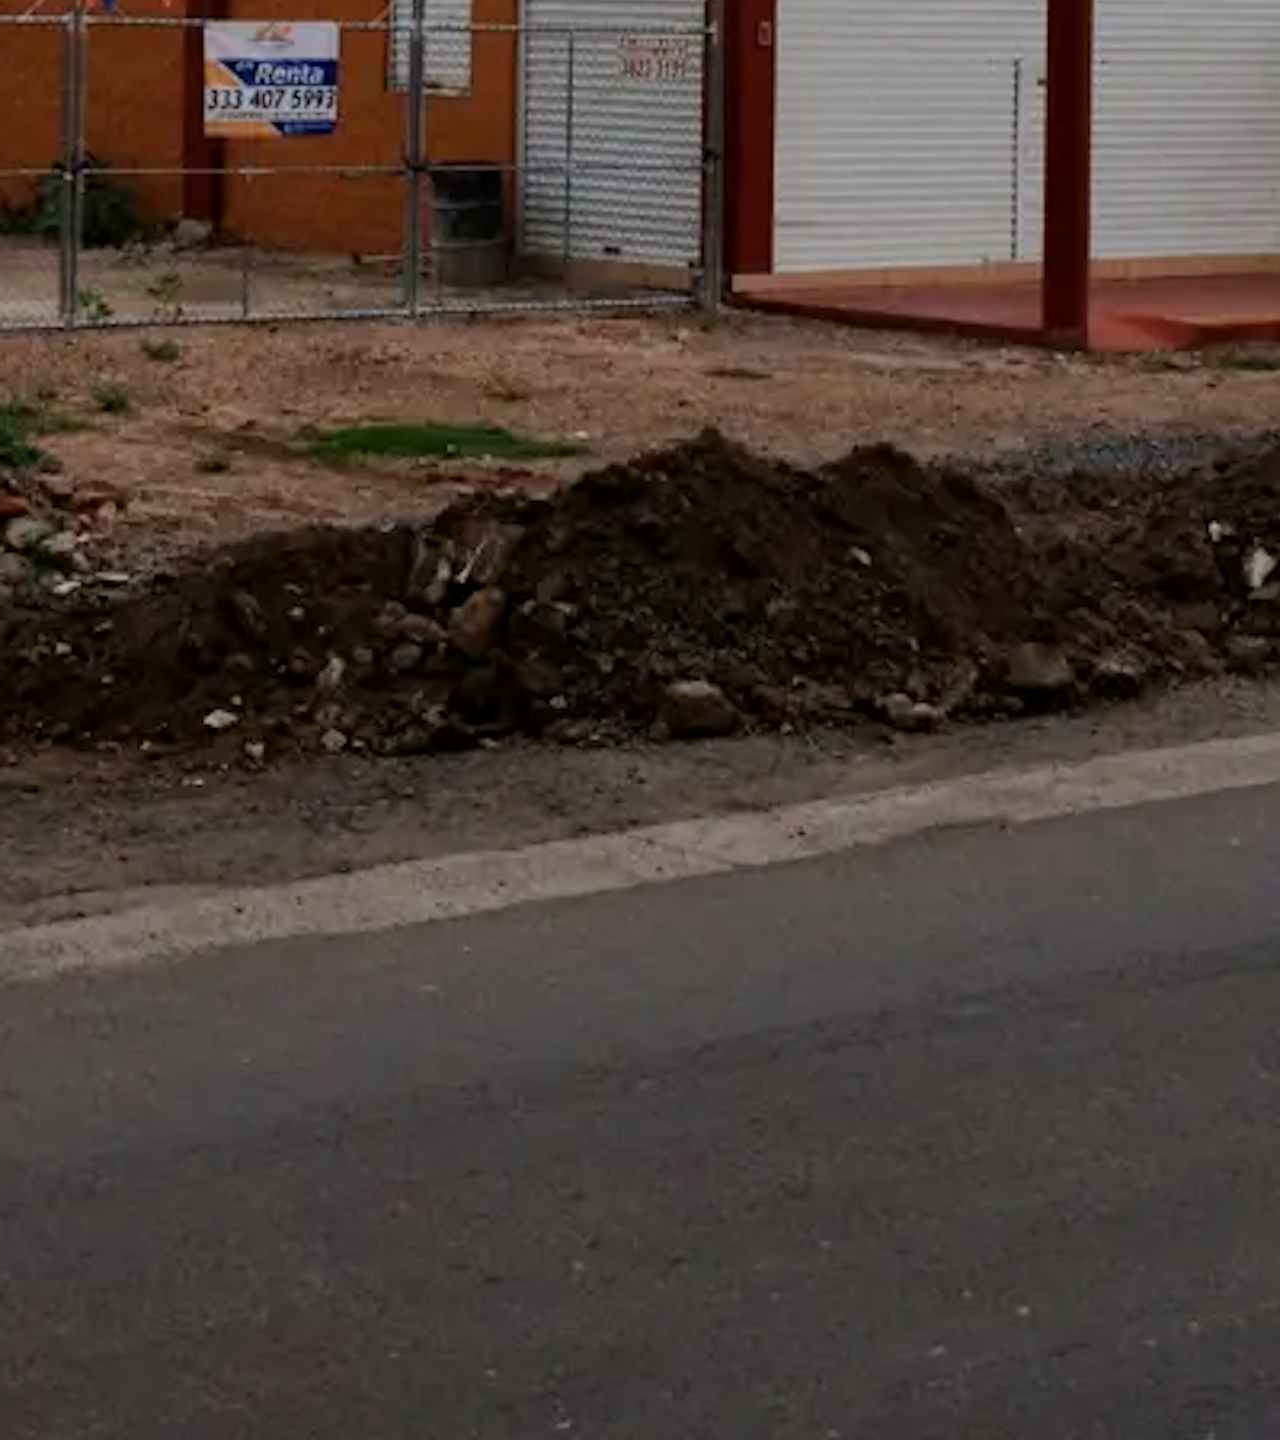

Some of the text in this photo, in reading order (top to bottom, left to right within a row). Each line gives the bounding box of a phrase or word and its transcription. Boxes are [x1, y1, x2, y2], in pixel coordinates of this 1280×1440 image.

[254, 62, 325, 84] Renta
[207, 89, 334, 110] 333 407 5993
